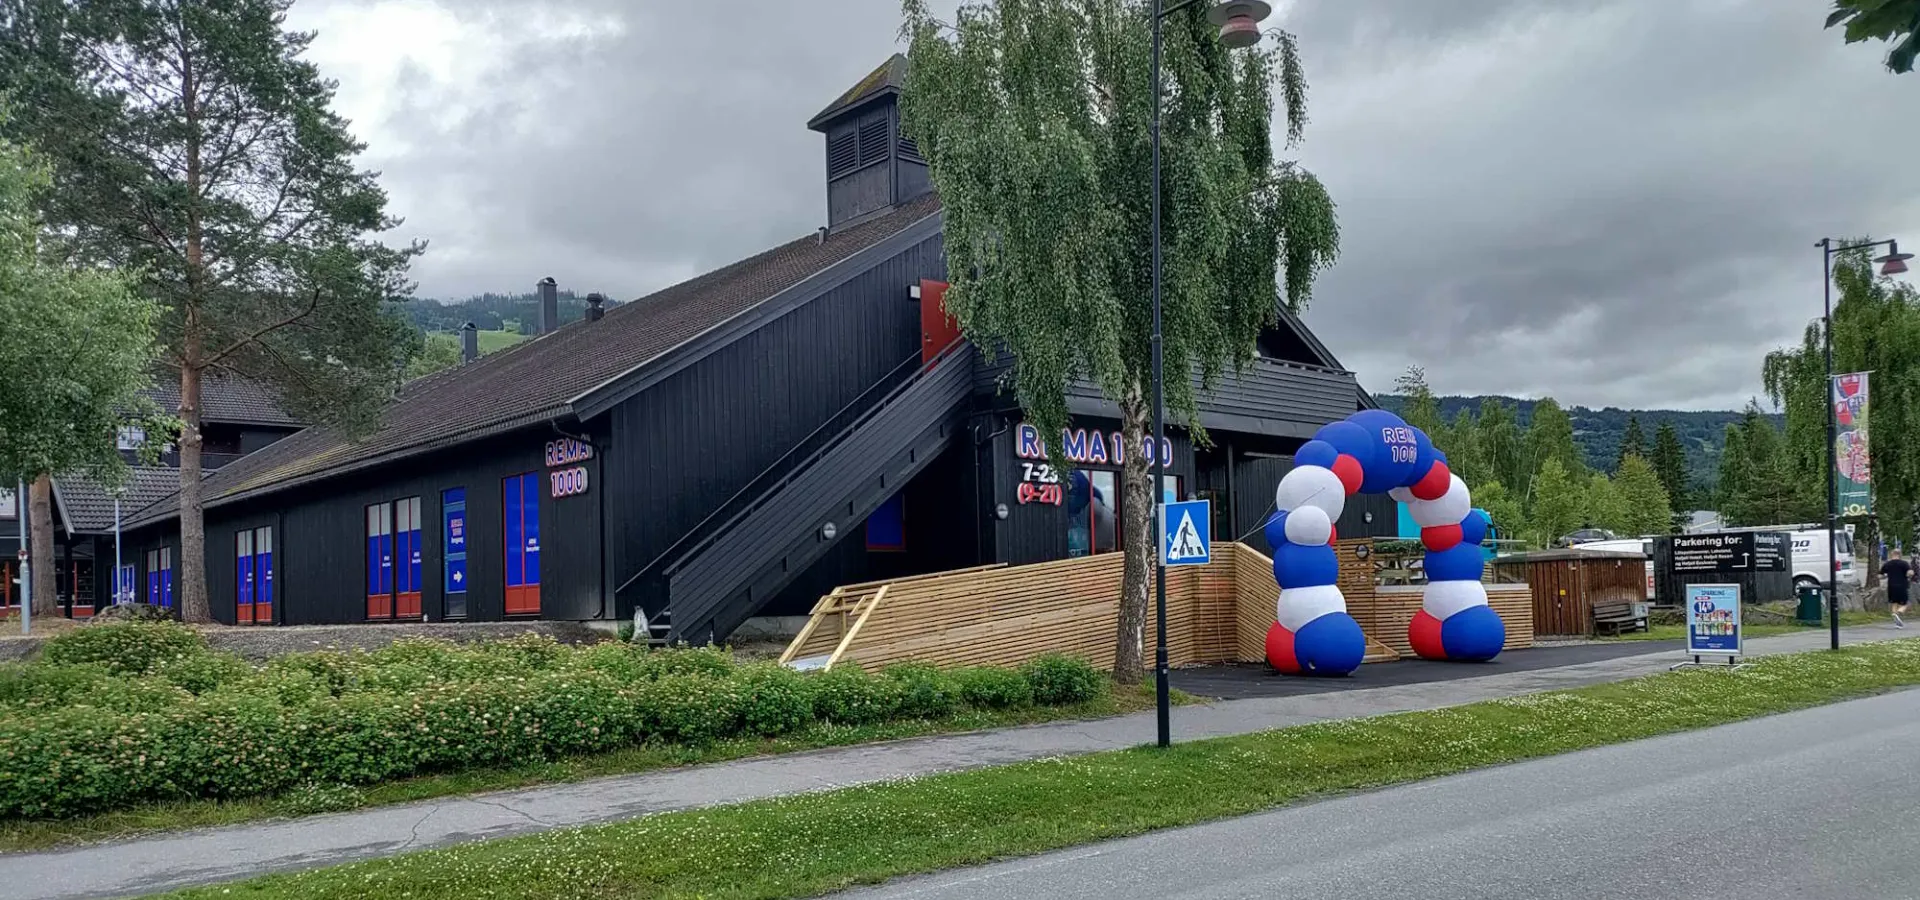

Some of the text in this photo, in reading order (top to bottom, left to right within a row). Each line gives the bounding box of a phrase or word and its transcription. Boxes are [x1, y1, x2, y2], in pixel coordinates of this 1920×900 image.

[545, 434, 592, 467] REMA
[1109, 431, 1172, 468] 100
[551, 467, 588, 497] 1000
[1017, 482, 1062, 506] (9-21)
[1674, 535, 1743, 547] Parkering for:
